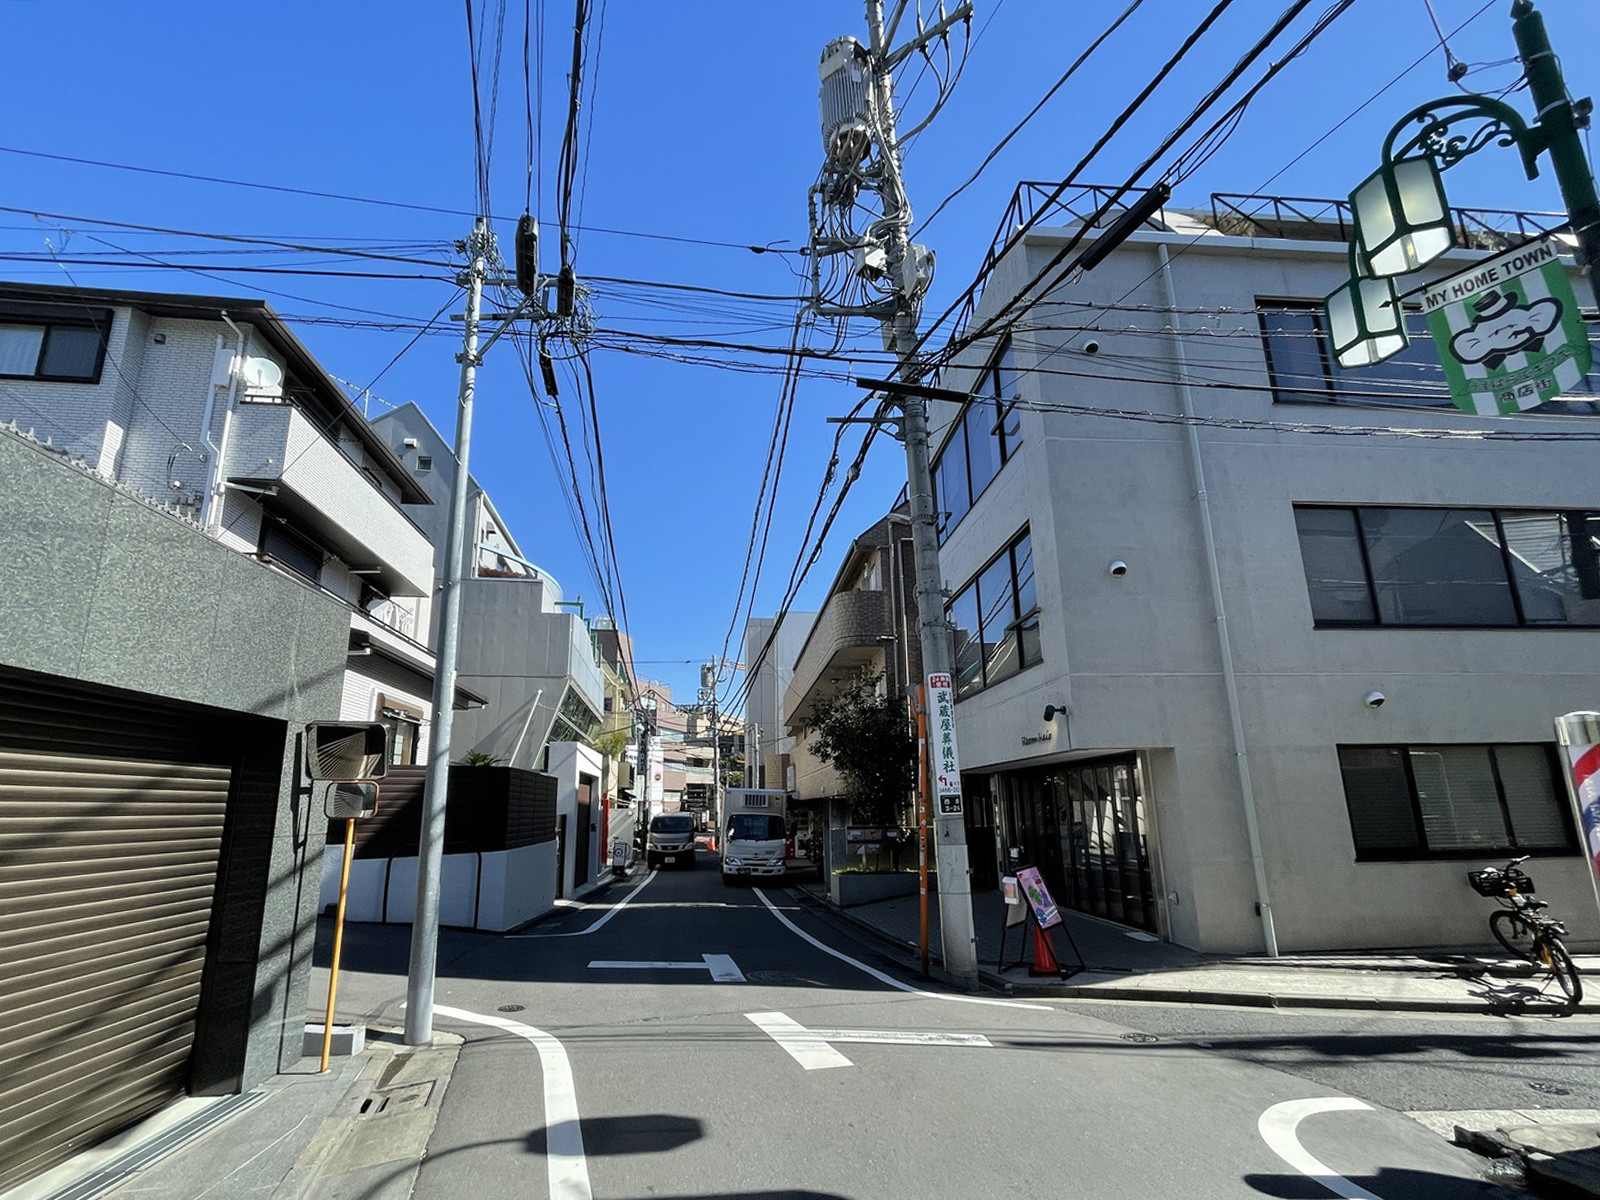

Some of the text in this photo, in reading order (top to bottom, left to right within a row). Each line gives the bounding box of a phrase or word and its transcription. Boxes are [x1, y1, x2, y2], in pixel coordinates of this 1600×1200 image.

[1425, 244, 1553, 309] MY HOME TOWN
[936, 690, 956, 773] 武蔵屋葬儀社
